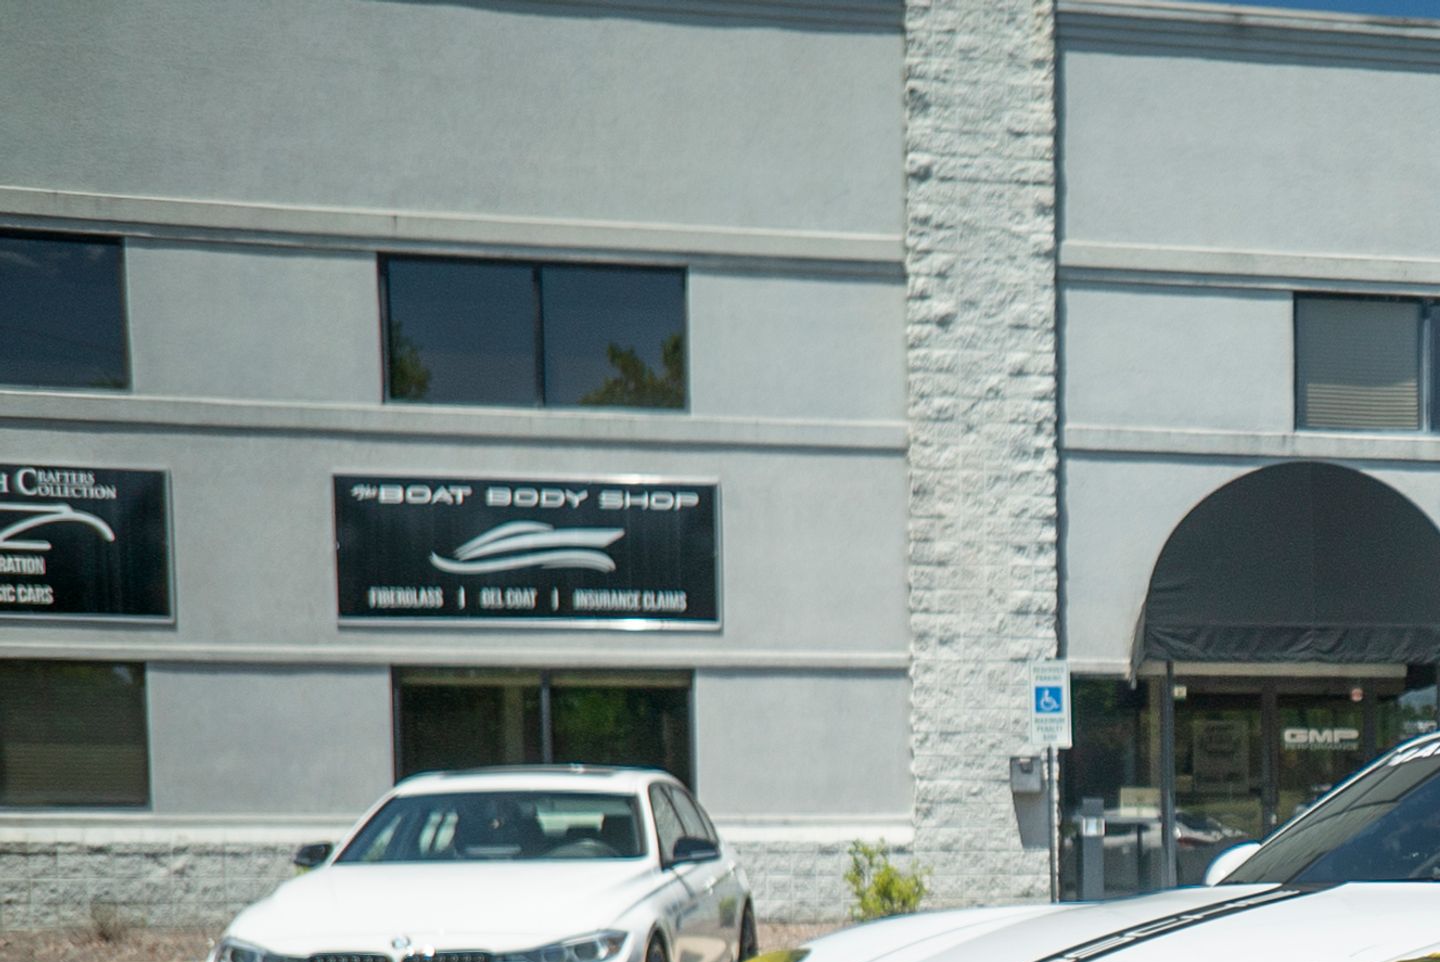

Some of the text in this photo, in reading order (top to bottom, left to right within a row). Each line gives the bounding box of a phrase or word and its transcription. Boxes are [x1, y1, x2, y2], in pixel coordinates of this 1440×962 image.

[379, 485, 472, 505] BOAT
[485, 486, 588, 508] BODY
[600, 490, 699, 511] SHOP
[17, 585, 54, 604] CARS
[368, 586, 443, 609] FIBERGLASS
[507, 588, 538, 610] COAT
[573, 589, 641, 611] INSURANCE
[643, 592, 687, 613] CLAIMS
[1284, 728, 1359, 743] GMP
